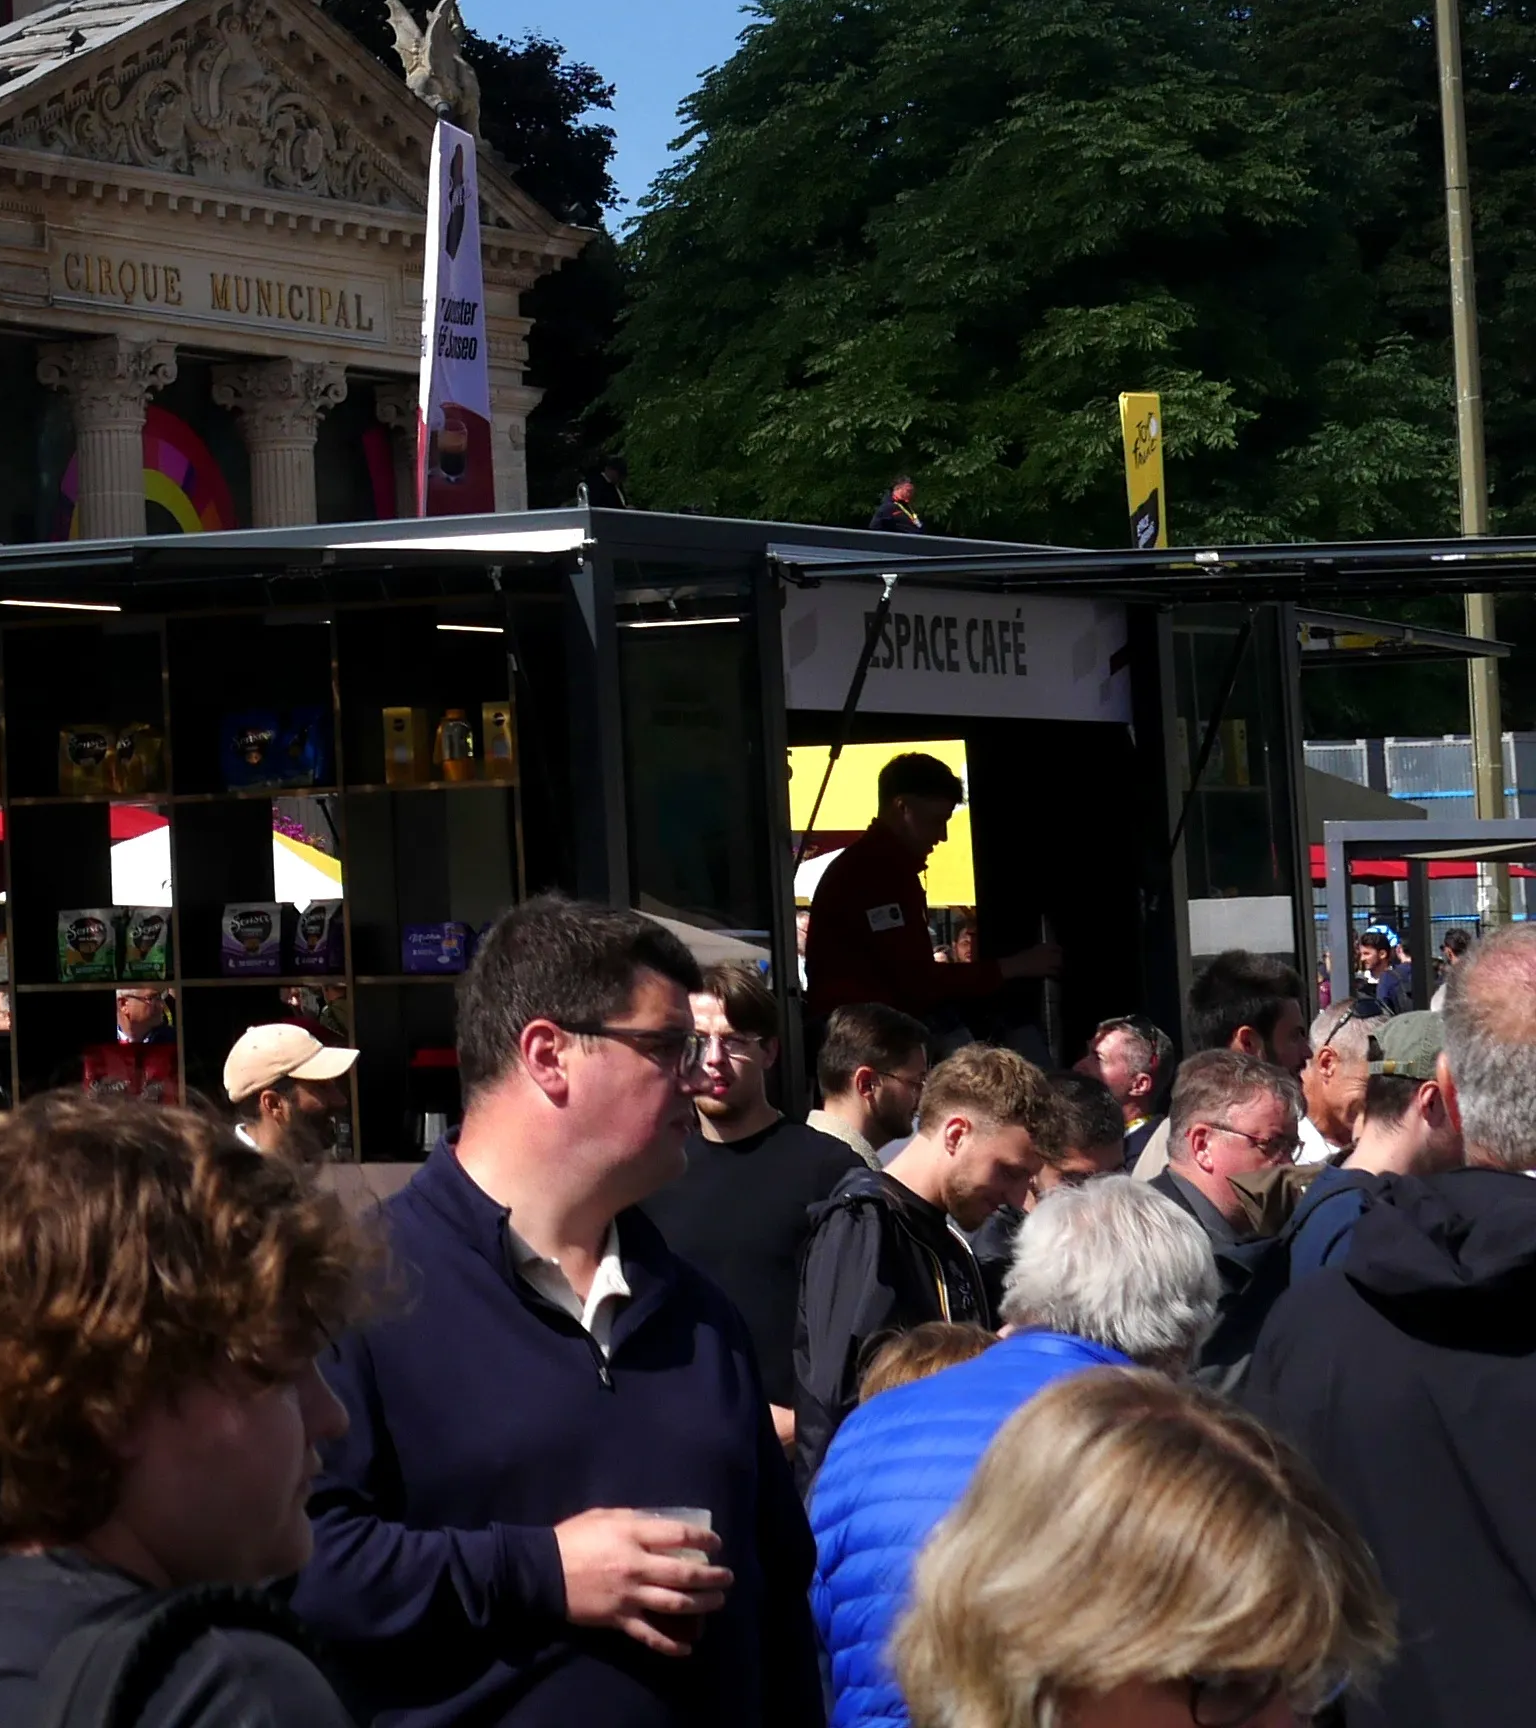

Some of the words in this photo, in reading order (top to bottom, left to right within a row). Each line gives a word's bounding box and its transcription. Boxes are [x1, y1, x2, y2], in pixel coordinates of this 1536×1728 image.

[64, 252, 182, 306] CIRQUE
[210, 272, 374, 332] MUNICIPAL
[864, 611, 960, 672] ESPACE
[965, 607, 1027, 676] CAFÉ
